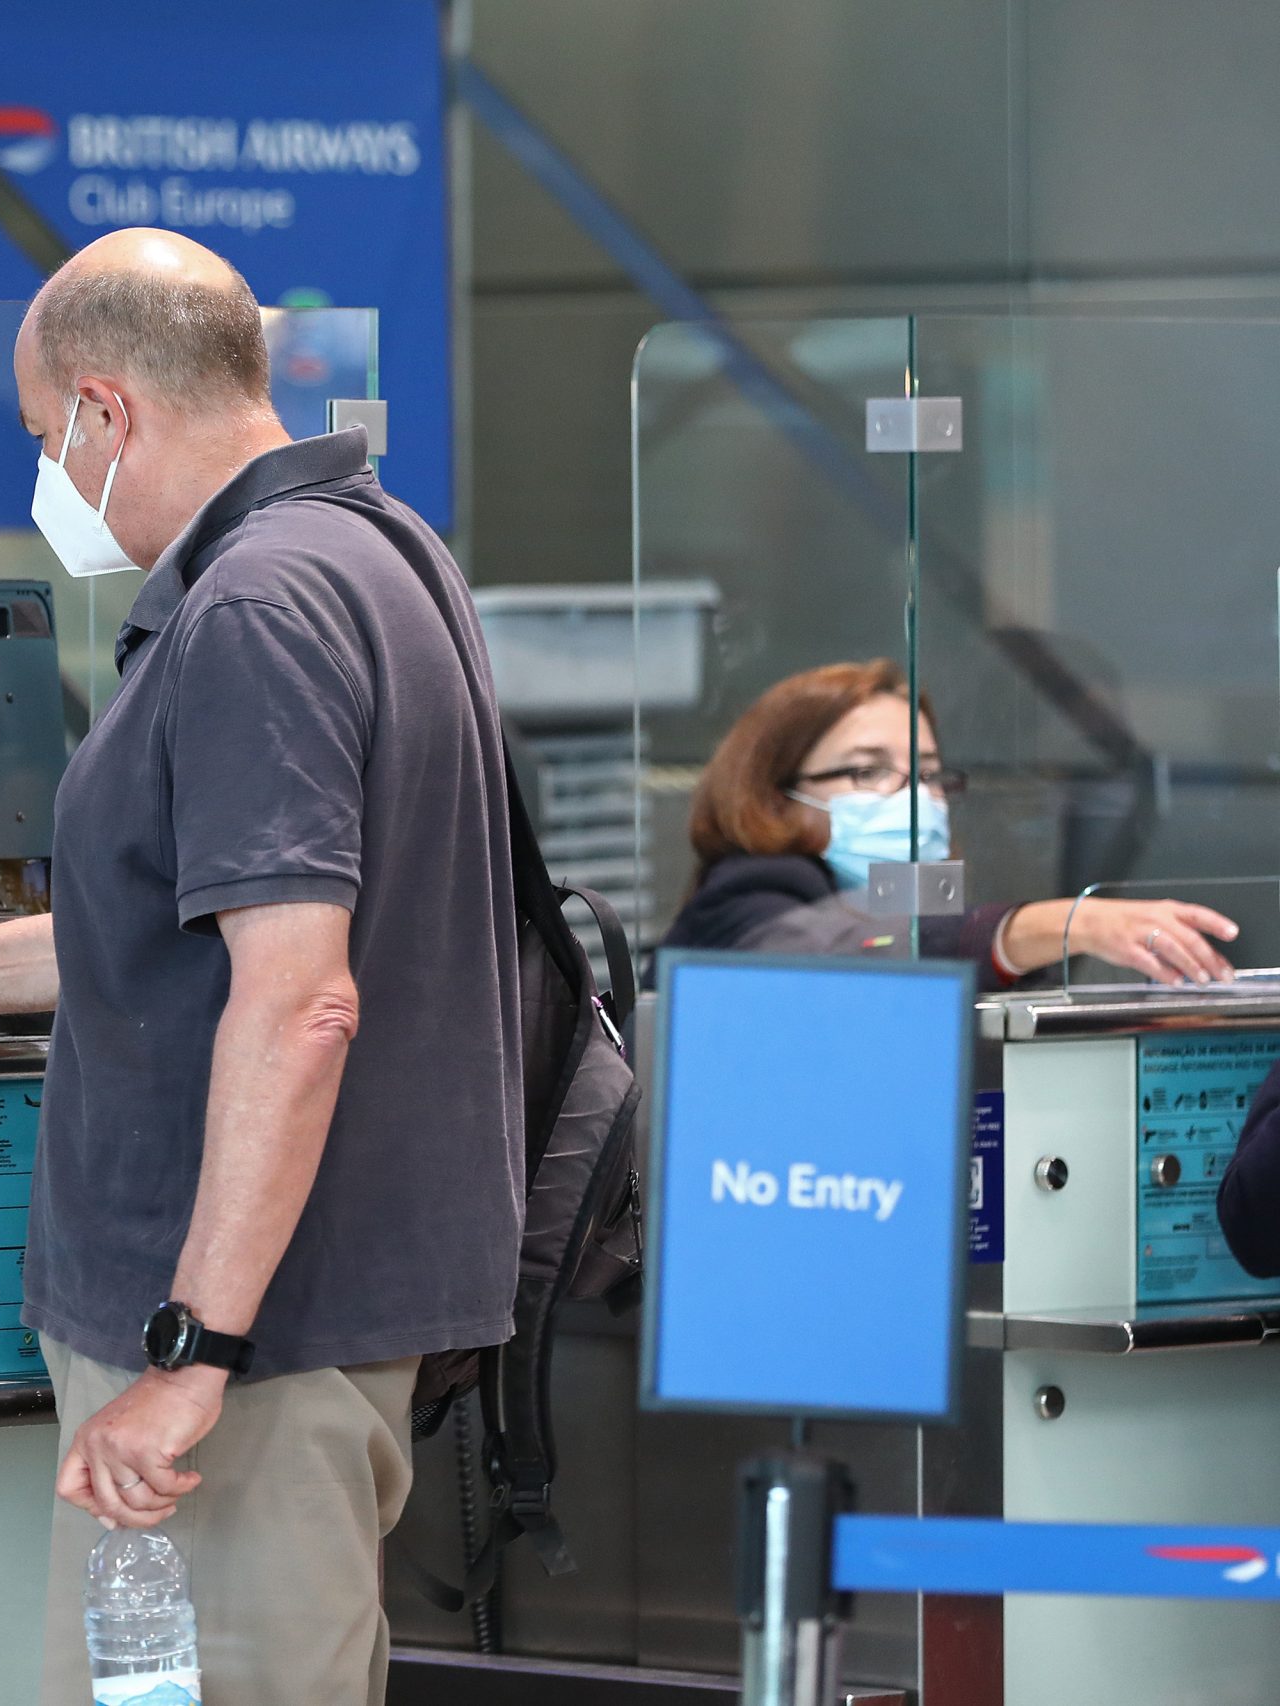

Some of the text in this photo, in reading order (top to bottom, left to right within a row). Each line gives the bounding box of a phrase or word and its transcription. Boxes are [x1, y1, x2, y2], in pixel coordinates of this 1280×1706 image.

[69, 113, 420, 176] BRITISH AIRWAYS
[69, 174, 295, 235] Club Europe
[711, 1159, 903, 1222] No Entry
